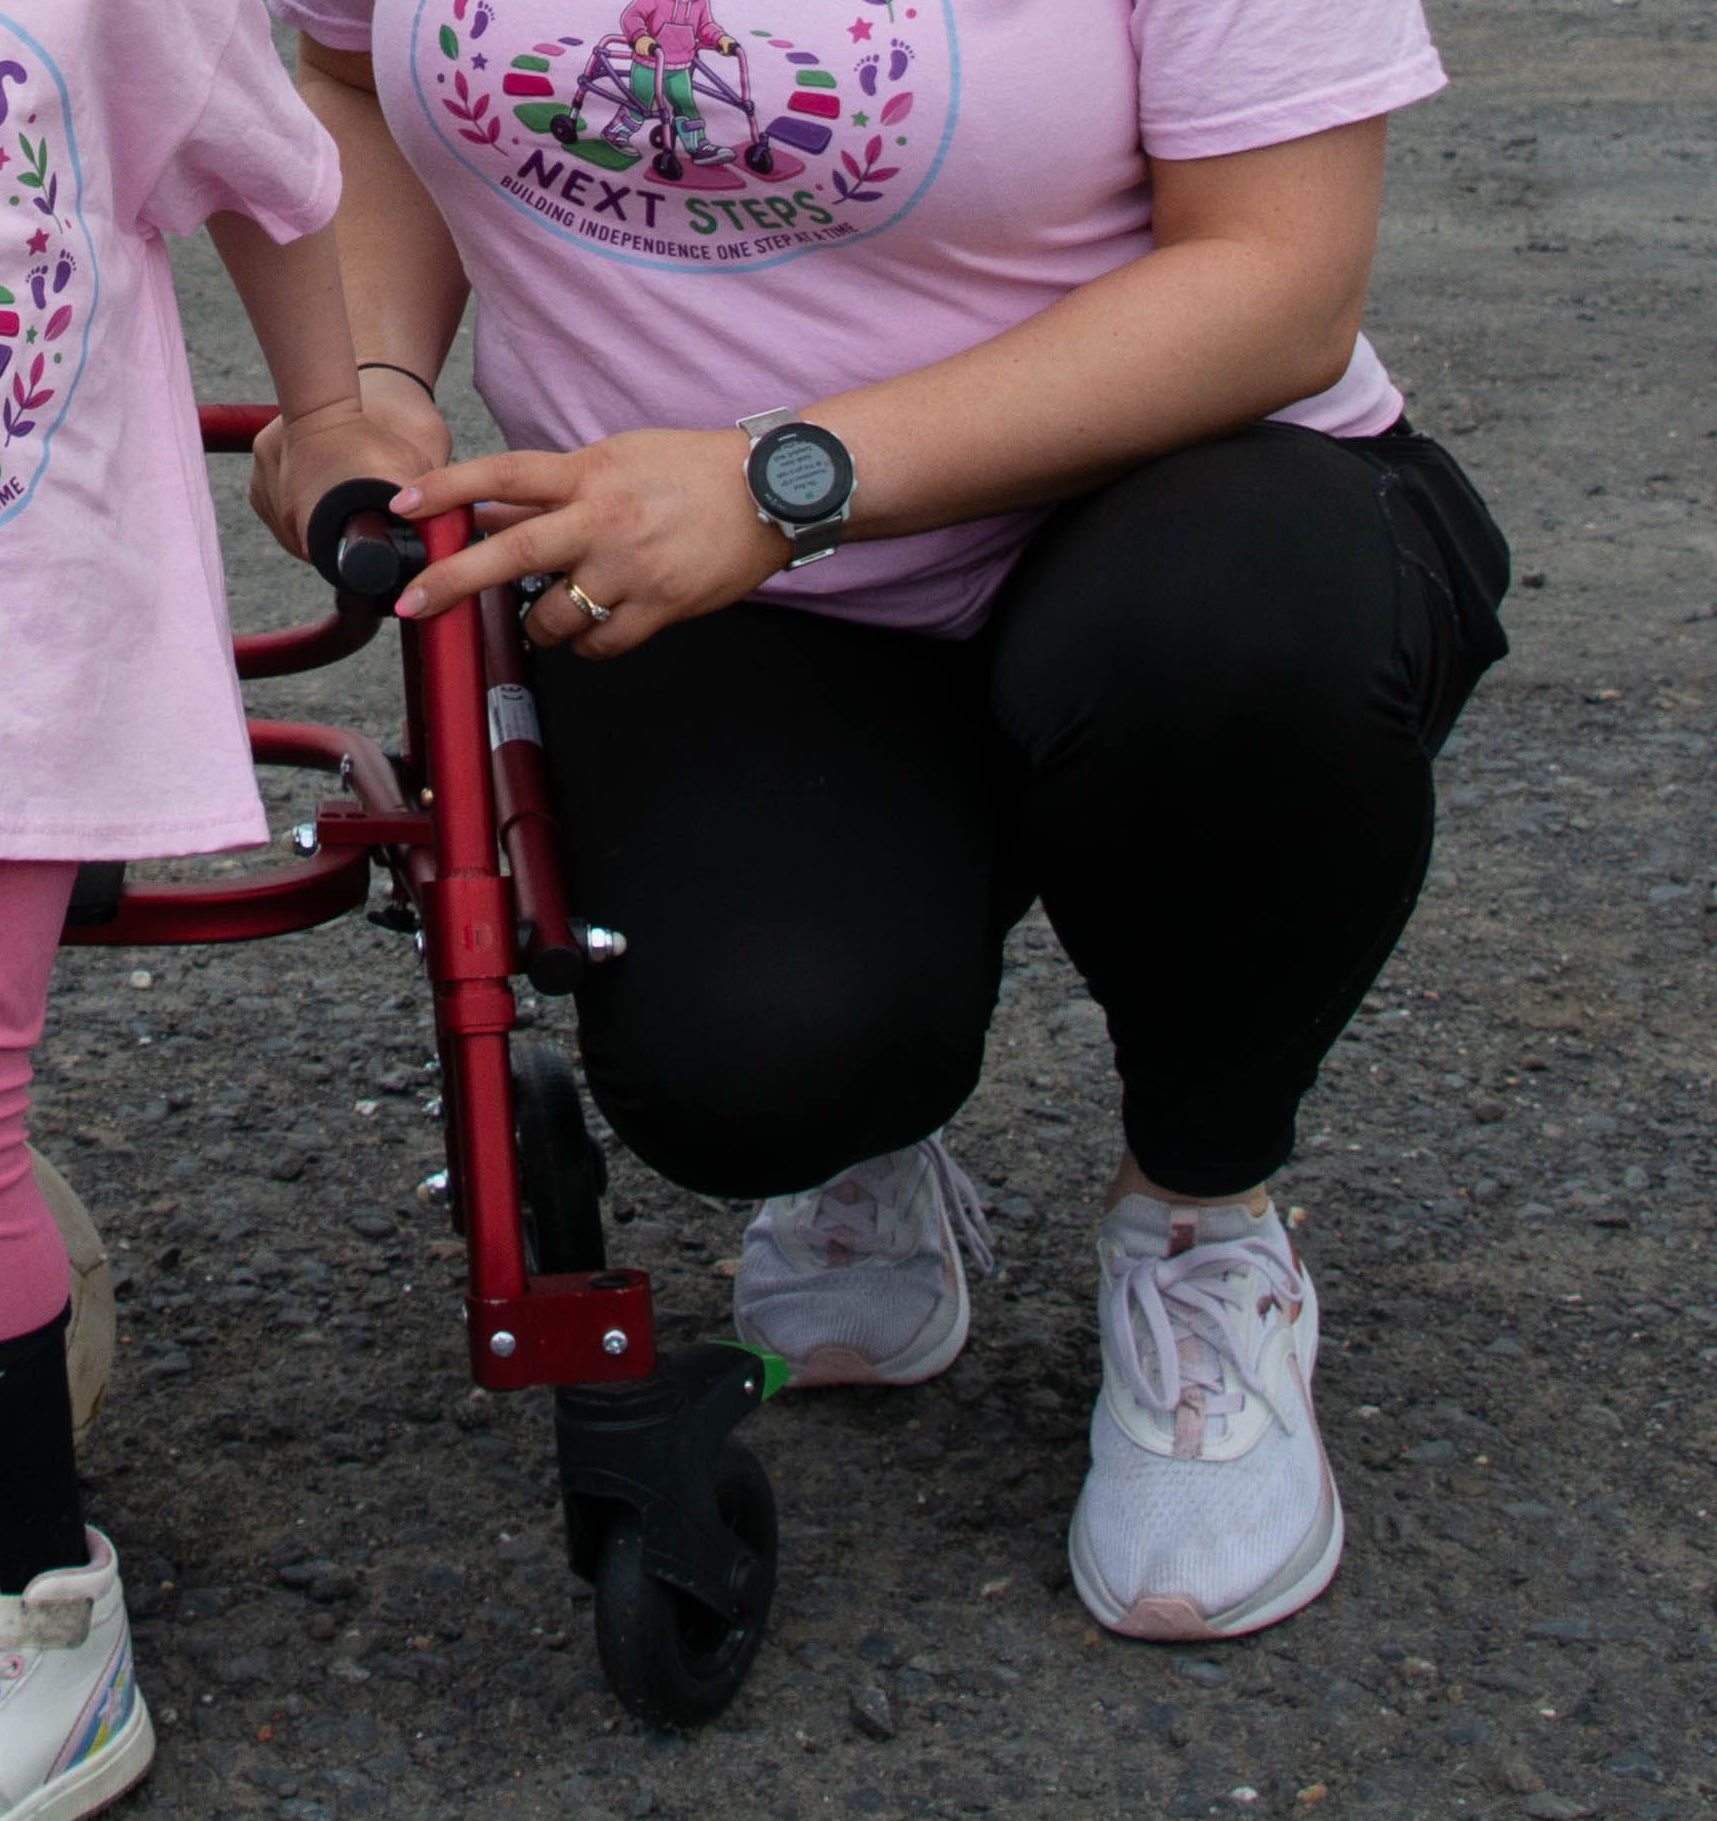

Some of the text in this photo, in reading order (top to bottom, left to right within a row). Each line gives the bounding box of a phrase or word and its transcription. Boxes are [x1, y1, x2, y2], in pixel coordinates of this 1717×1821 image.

[500, 175, 576, 228] BUILDING
[578, 218, 711, 260] INDEPENDENCE
[717, 241, 752, 260] ONE
[754, 234, 792, 254] STEP
[517, 149, 834, 235] NEXT STEPS
